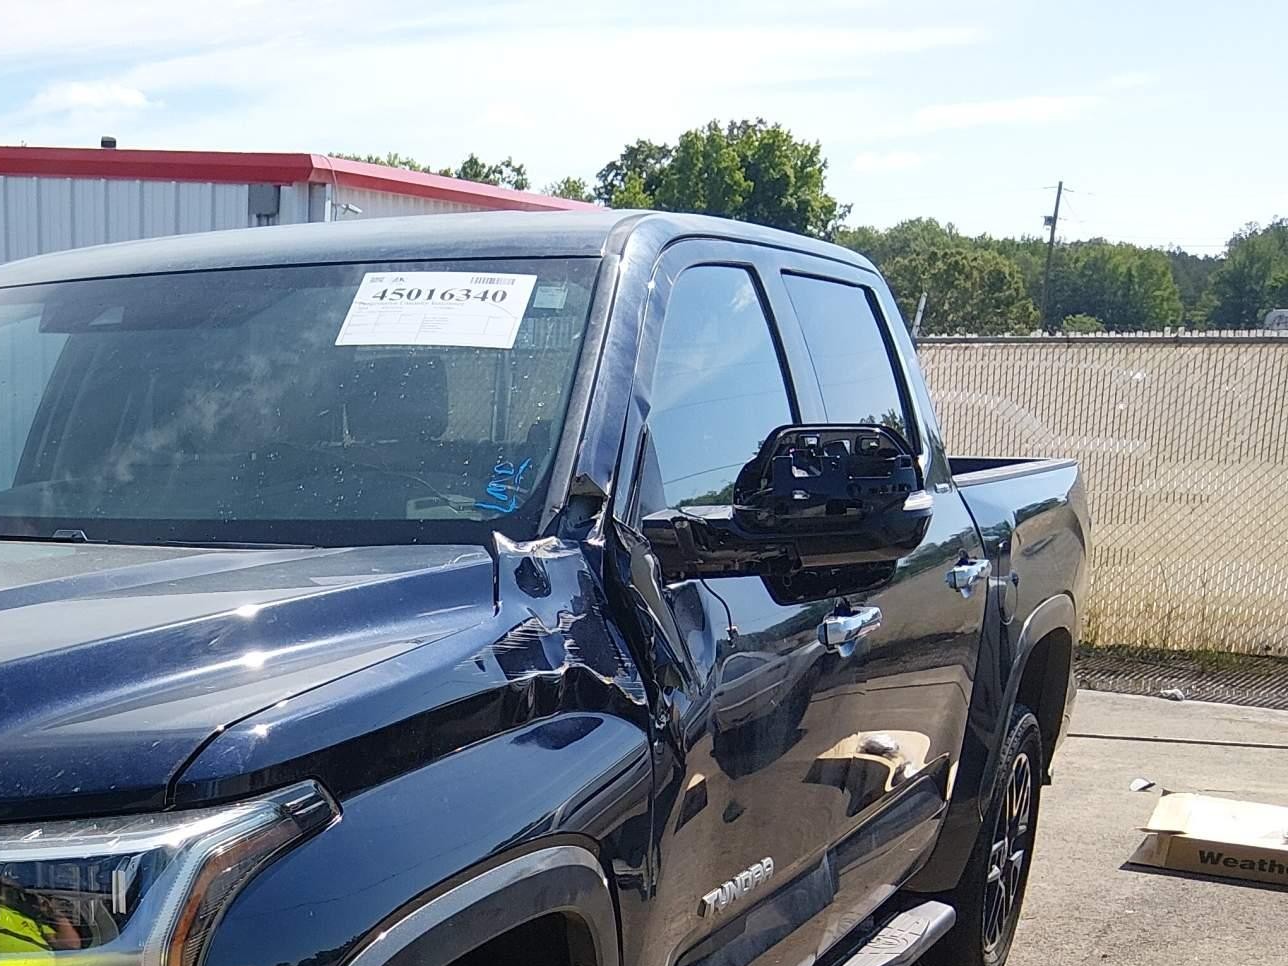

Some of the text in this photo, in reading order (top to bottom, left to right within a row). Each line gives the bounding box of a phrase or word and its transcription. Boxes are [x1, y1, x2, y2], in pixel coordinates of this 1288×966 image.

[372, 287, 508, 304] 45016340
[1198, 849, 1288, 876] Weath
[697, 856, 775, 919] TUNDRA
